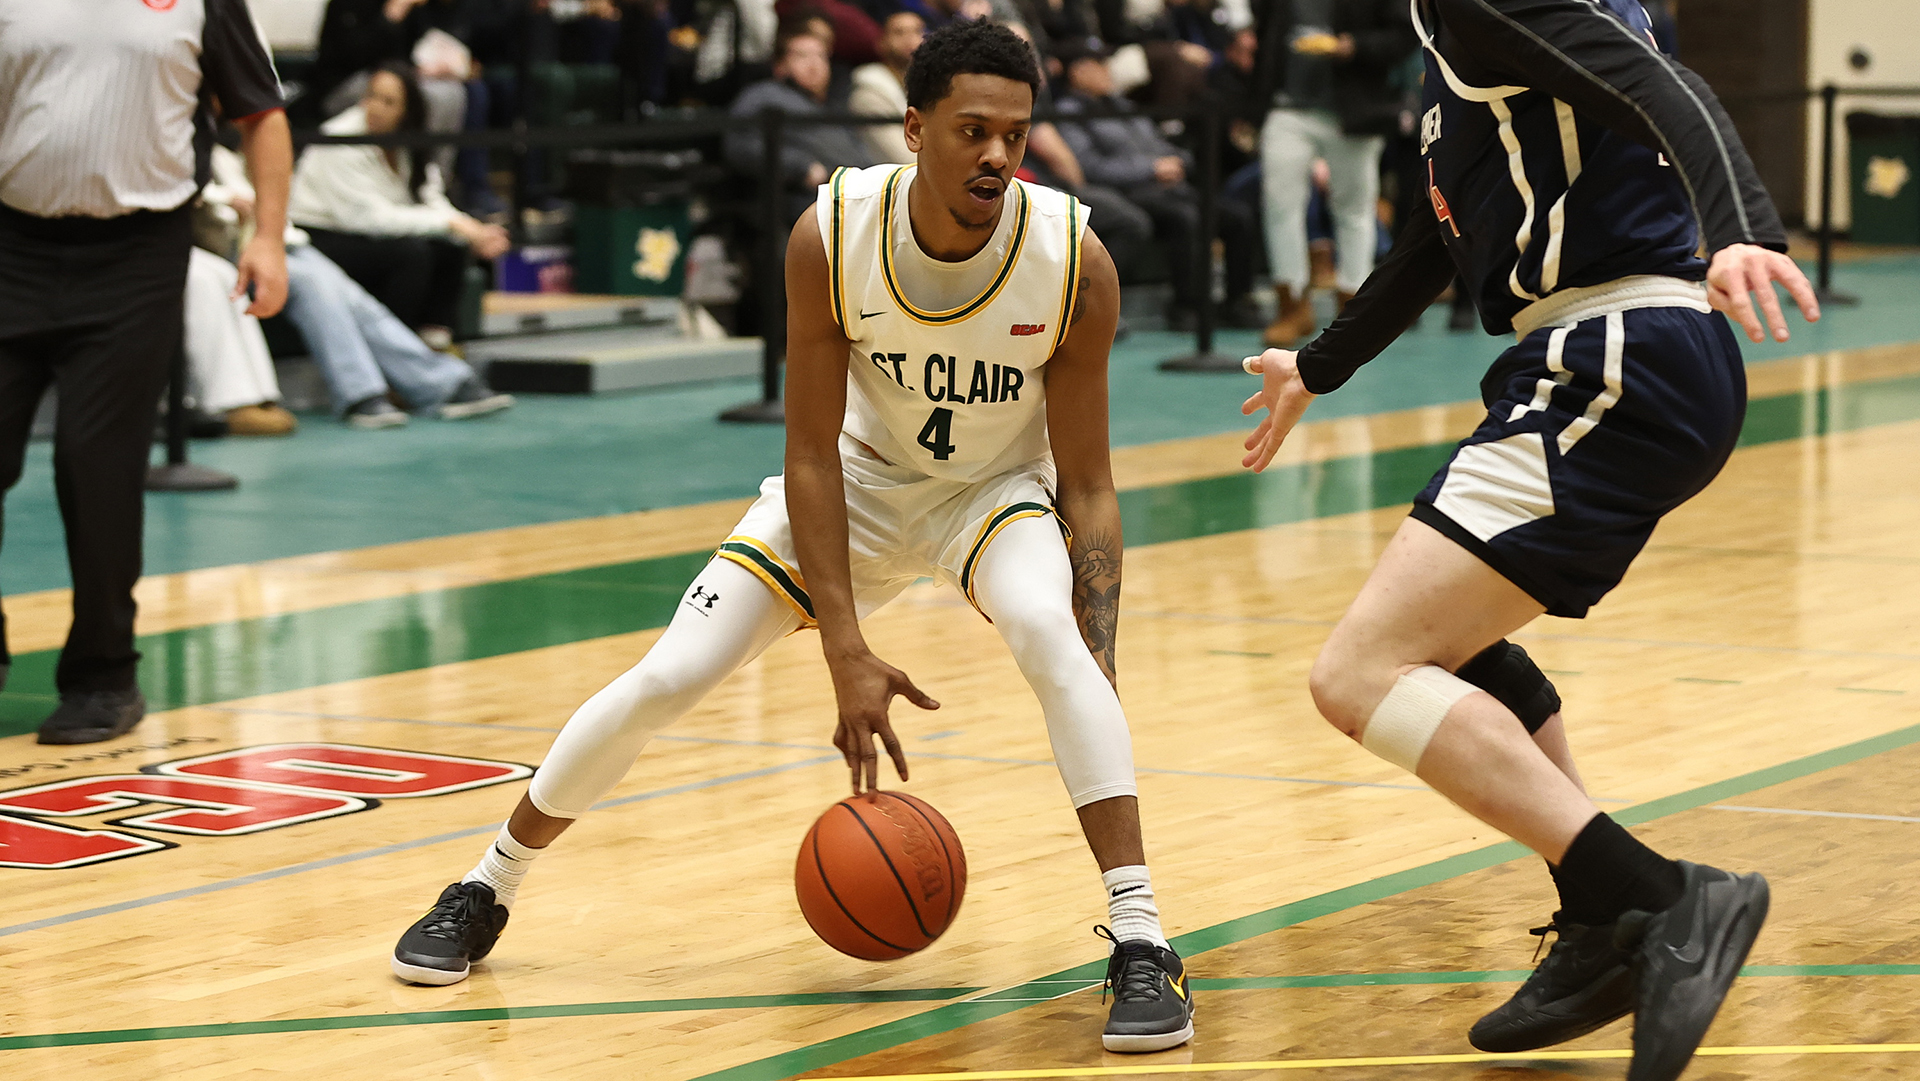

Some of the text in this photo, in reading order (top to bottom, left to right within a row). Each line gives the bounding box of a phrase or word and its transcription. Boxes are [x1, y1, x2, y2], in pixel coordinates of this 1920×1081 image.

[871, 352, 1024, 405] ST. CLAIR
[917, 407, 956, 461] 4
